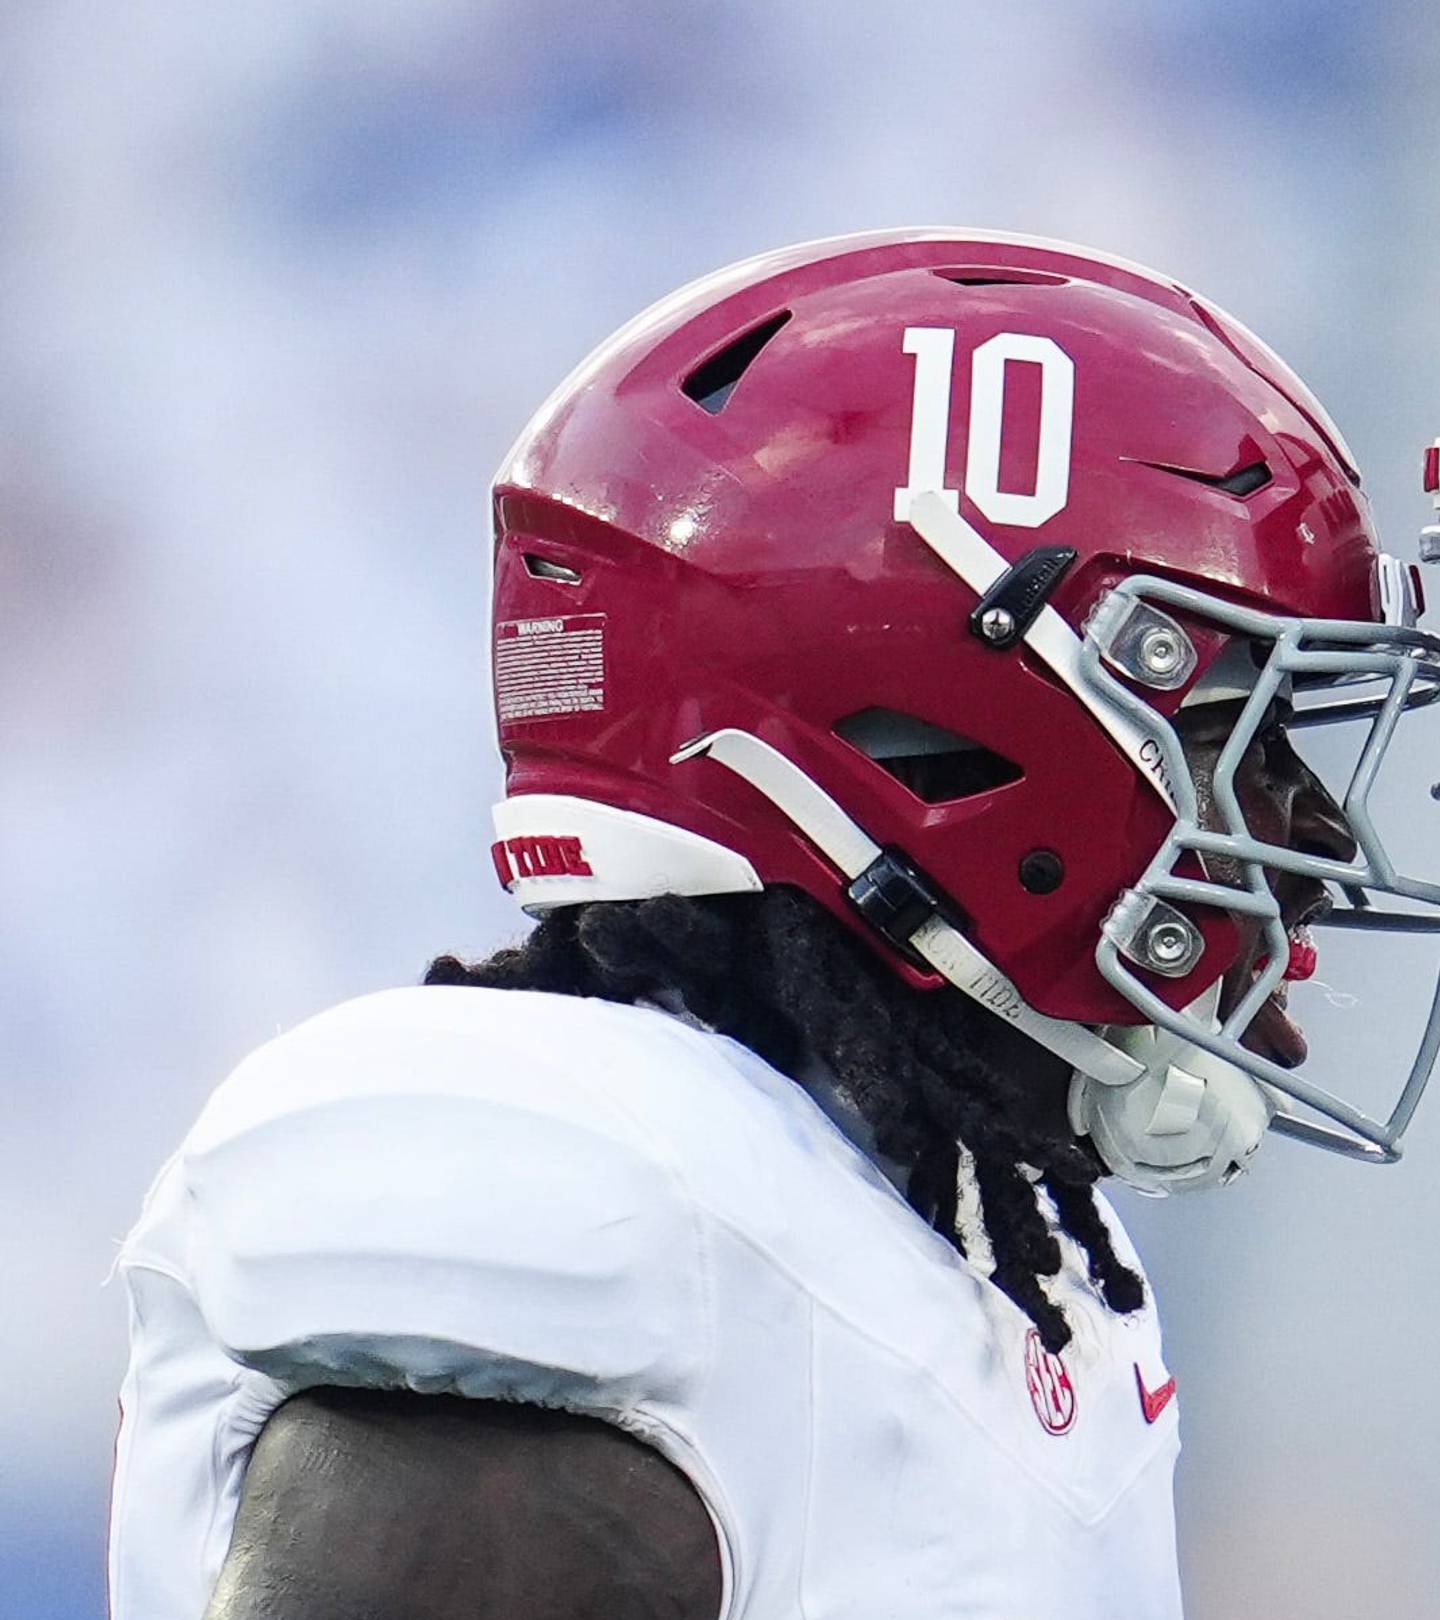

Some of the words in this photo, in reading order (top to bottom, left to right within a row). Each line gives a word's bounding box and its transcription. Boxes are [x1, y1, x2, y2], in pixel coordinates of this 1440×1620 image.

[893, 327, 1075, 528] 10
[517, 619, 565, 636] WARNING
[507, 835, 593, 878] TIDE
